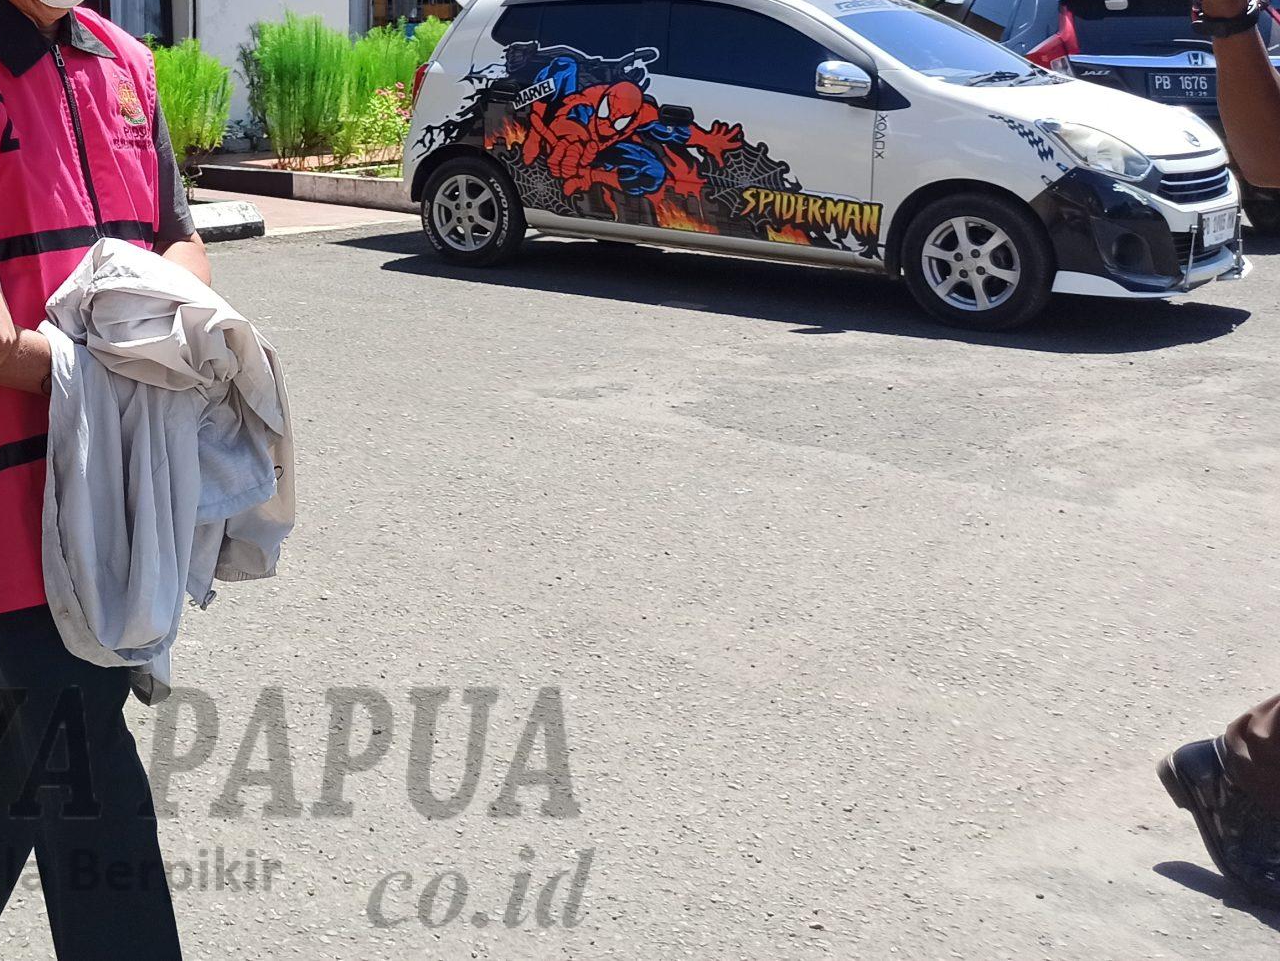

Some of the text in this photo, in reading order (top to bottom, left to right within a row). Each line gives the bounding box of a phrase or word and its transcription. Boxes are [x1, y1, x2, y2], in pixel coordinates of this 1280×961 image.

[512, 79, 555, 109] MARVEL
[1154, 75, 1208, 90] PB 1676
[488, 176, 509, 208] TOYO
